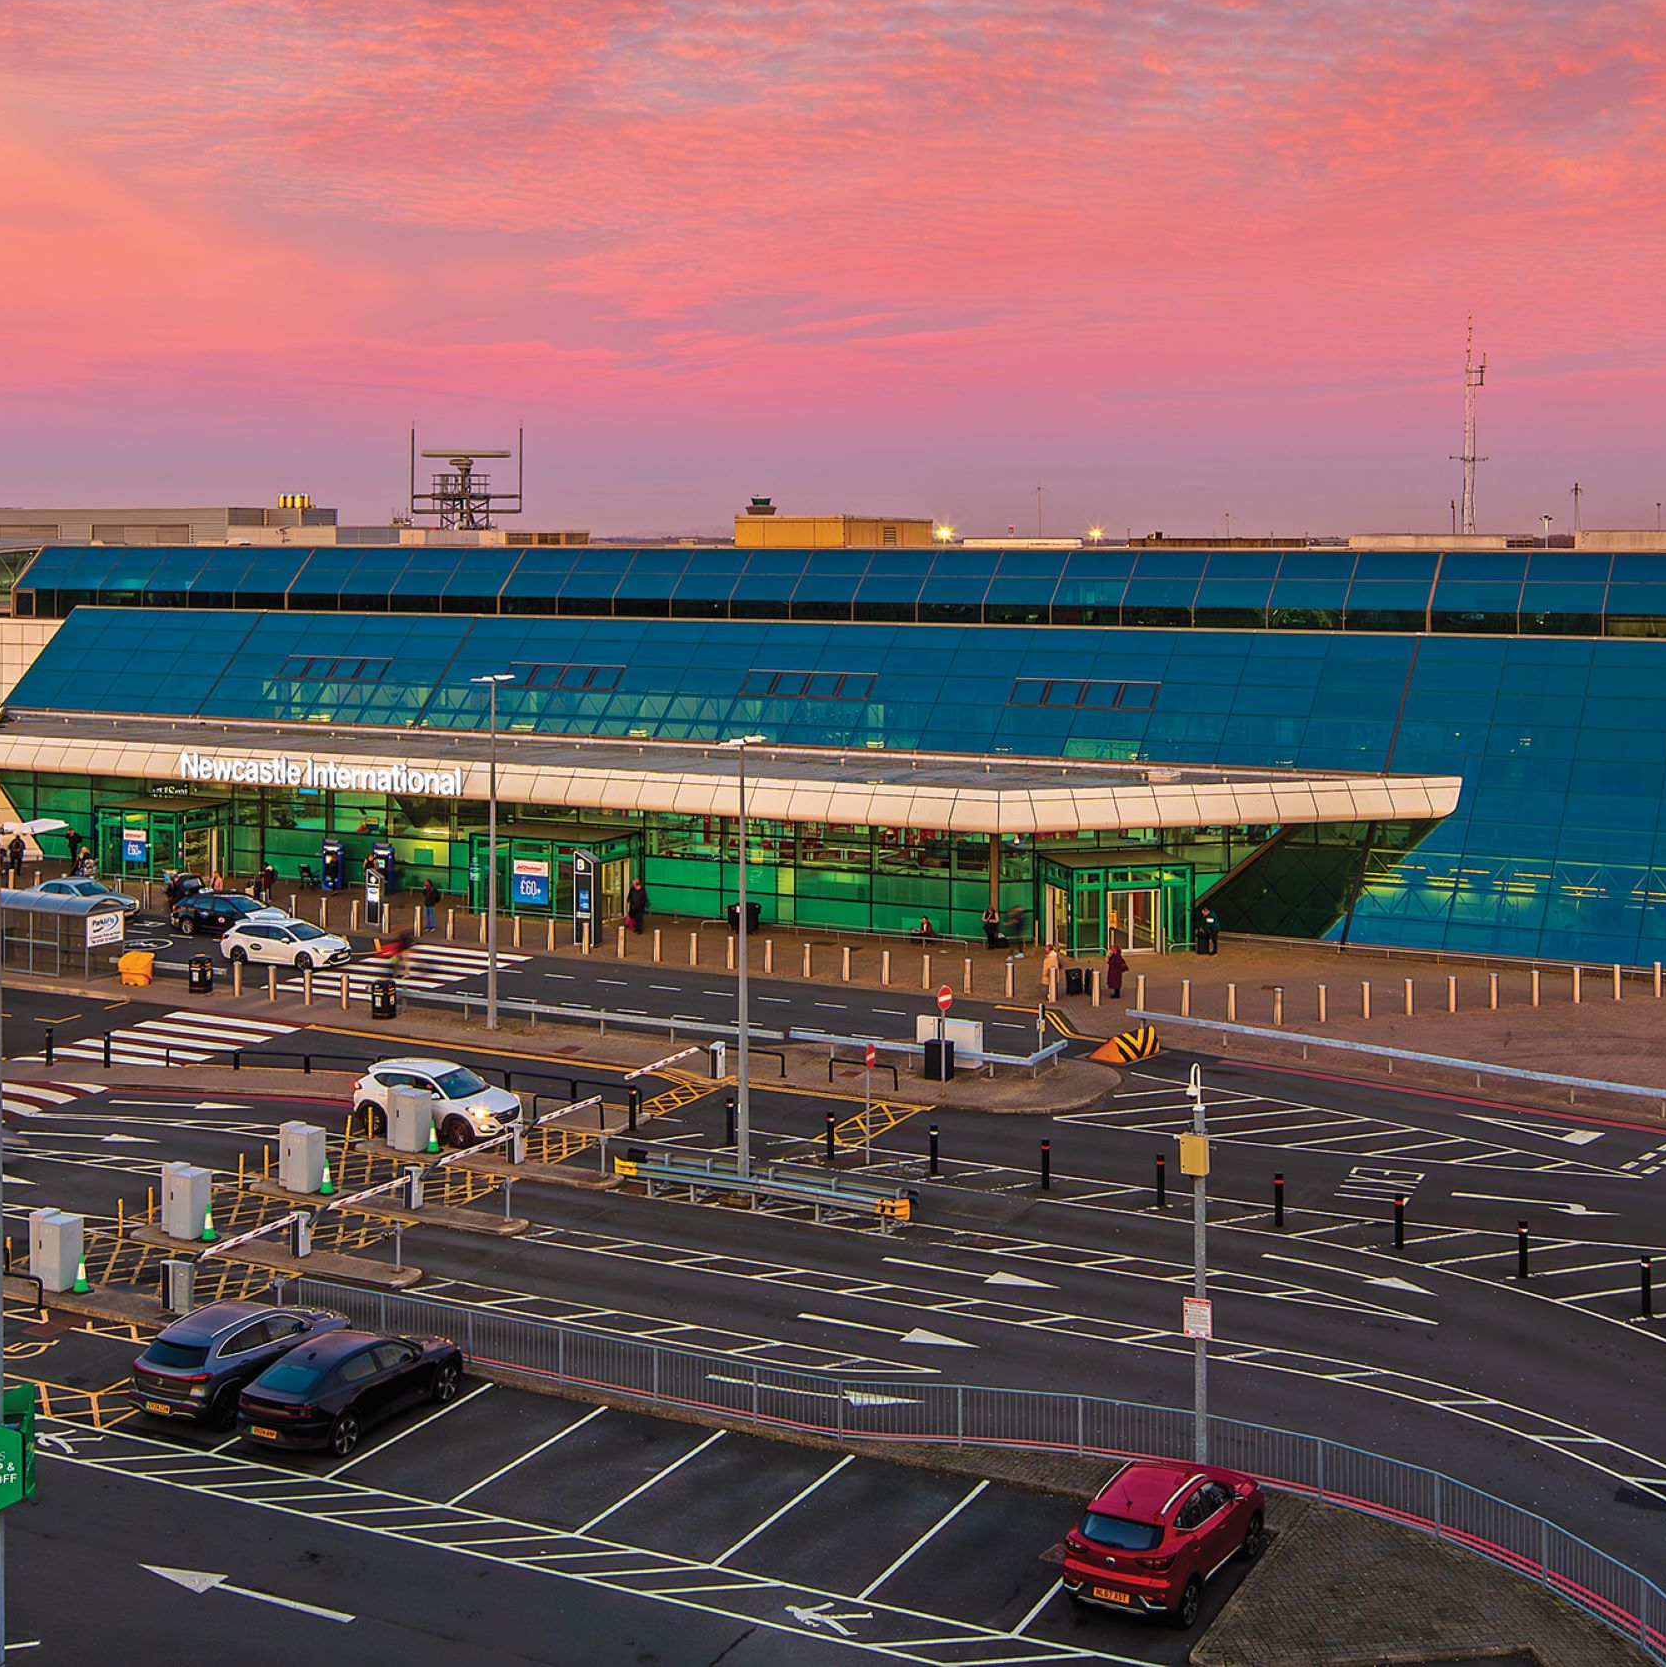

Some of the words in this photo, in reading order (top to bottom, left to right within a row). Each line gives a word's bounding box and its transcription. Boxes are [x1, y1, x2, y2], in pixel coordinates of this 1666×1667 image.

[180, 751, 302, 786] Newcastle
[307, 757, 463, 796] International
[576, 859, 585, 871] B
[7, 1461, 15, 1472] &
